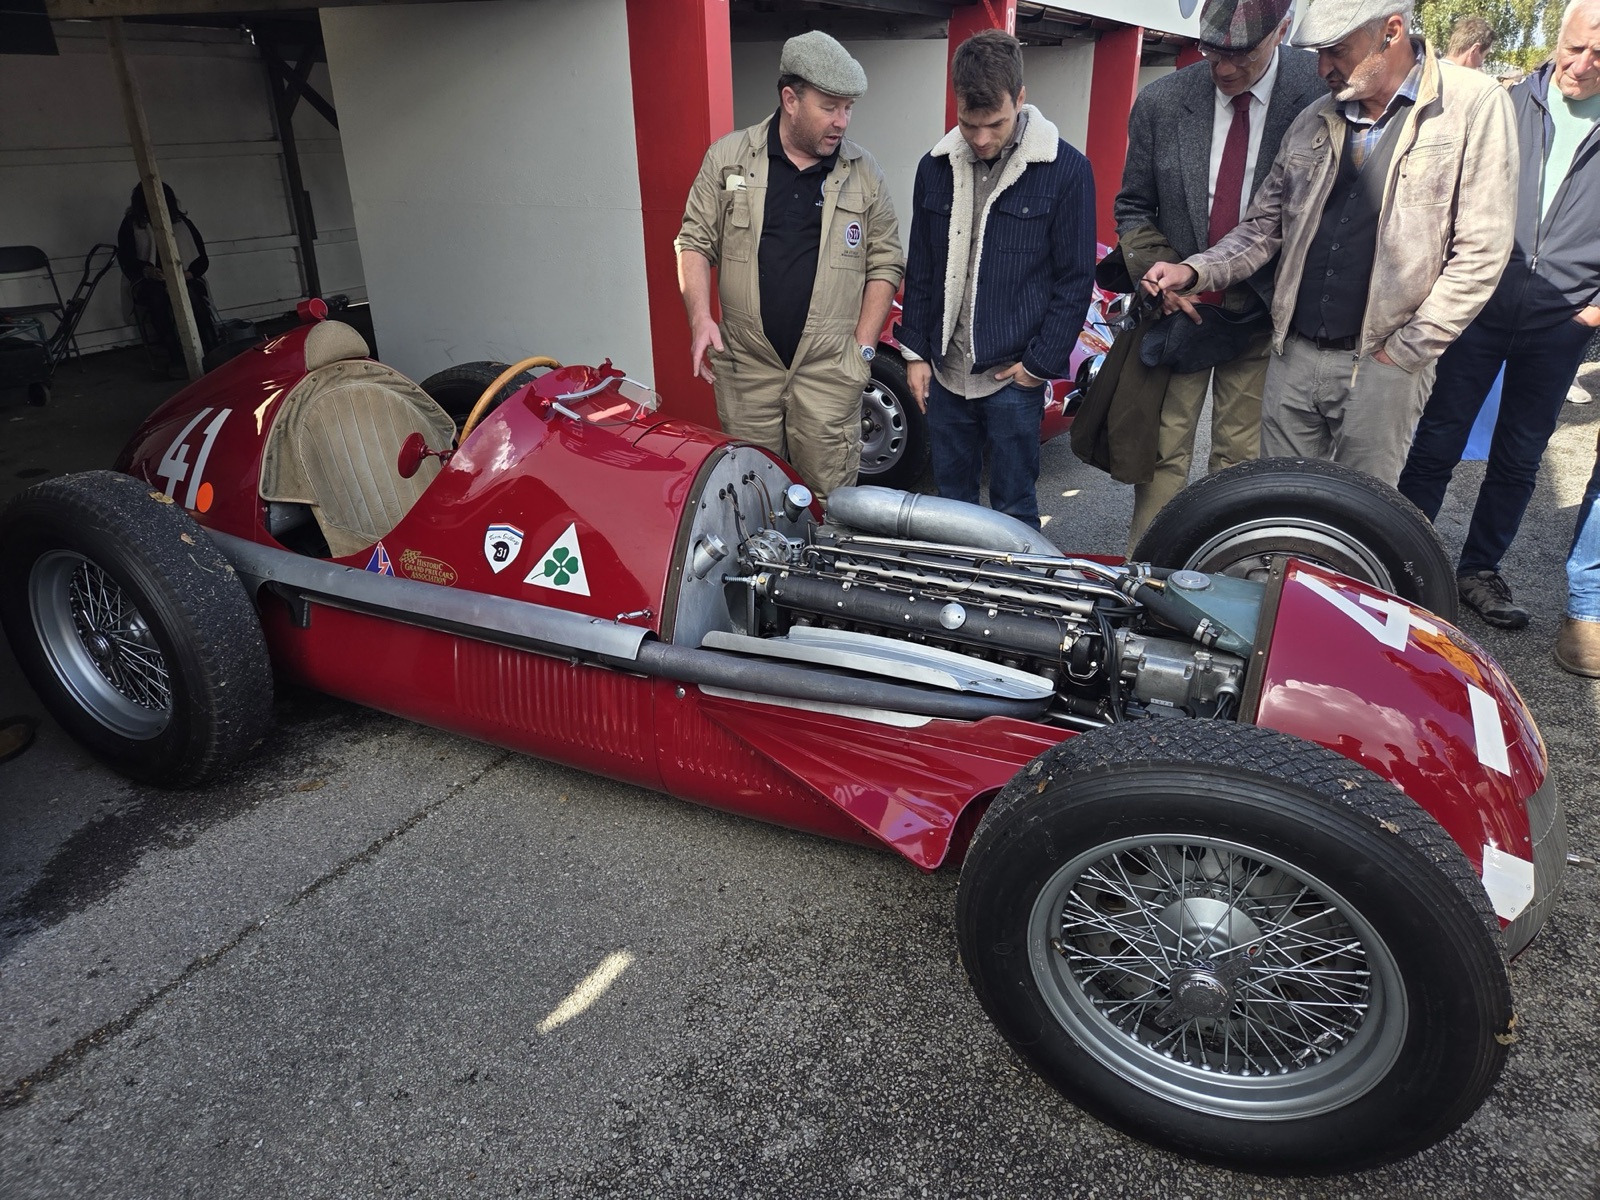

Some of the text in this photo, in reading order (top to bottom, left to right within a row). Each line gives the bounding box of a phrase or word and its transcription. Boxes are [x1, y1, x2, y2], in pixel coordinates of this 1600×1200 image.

[157, 407, 233, 510] 41
[496, 547, 507, 559] 31
[404, 562, 454, 581] GRAND PRIX CARS
[416, 558, 443, 571] HISTORIC
[410, 571, 447, 586] ASSOCIATION
